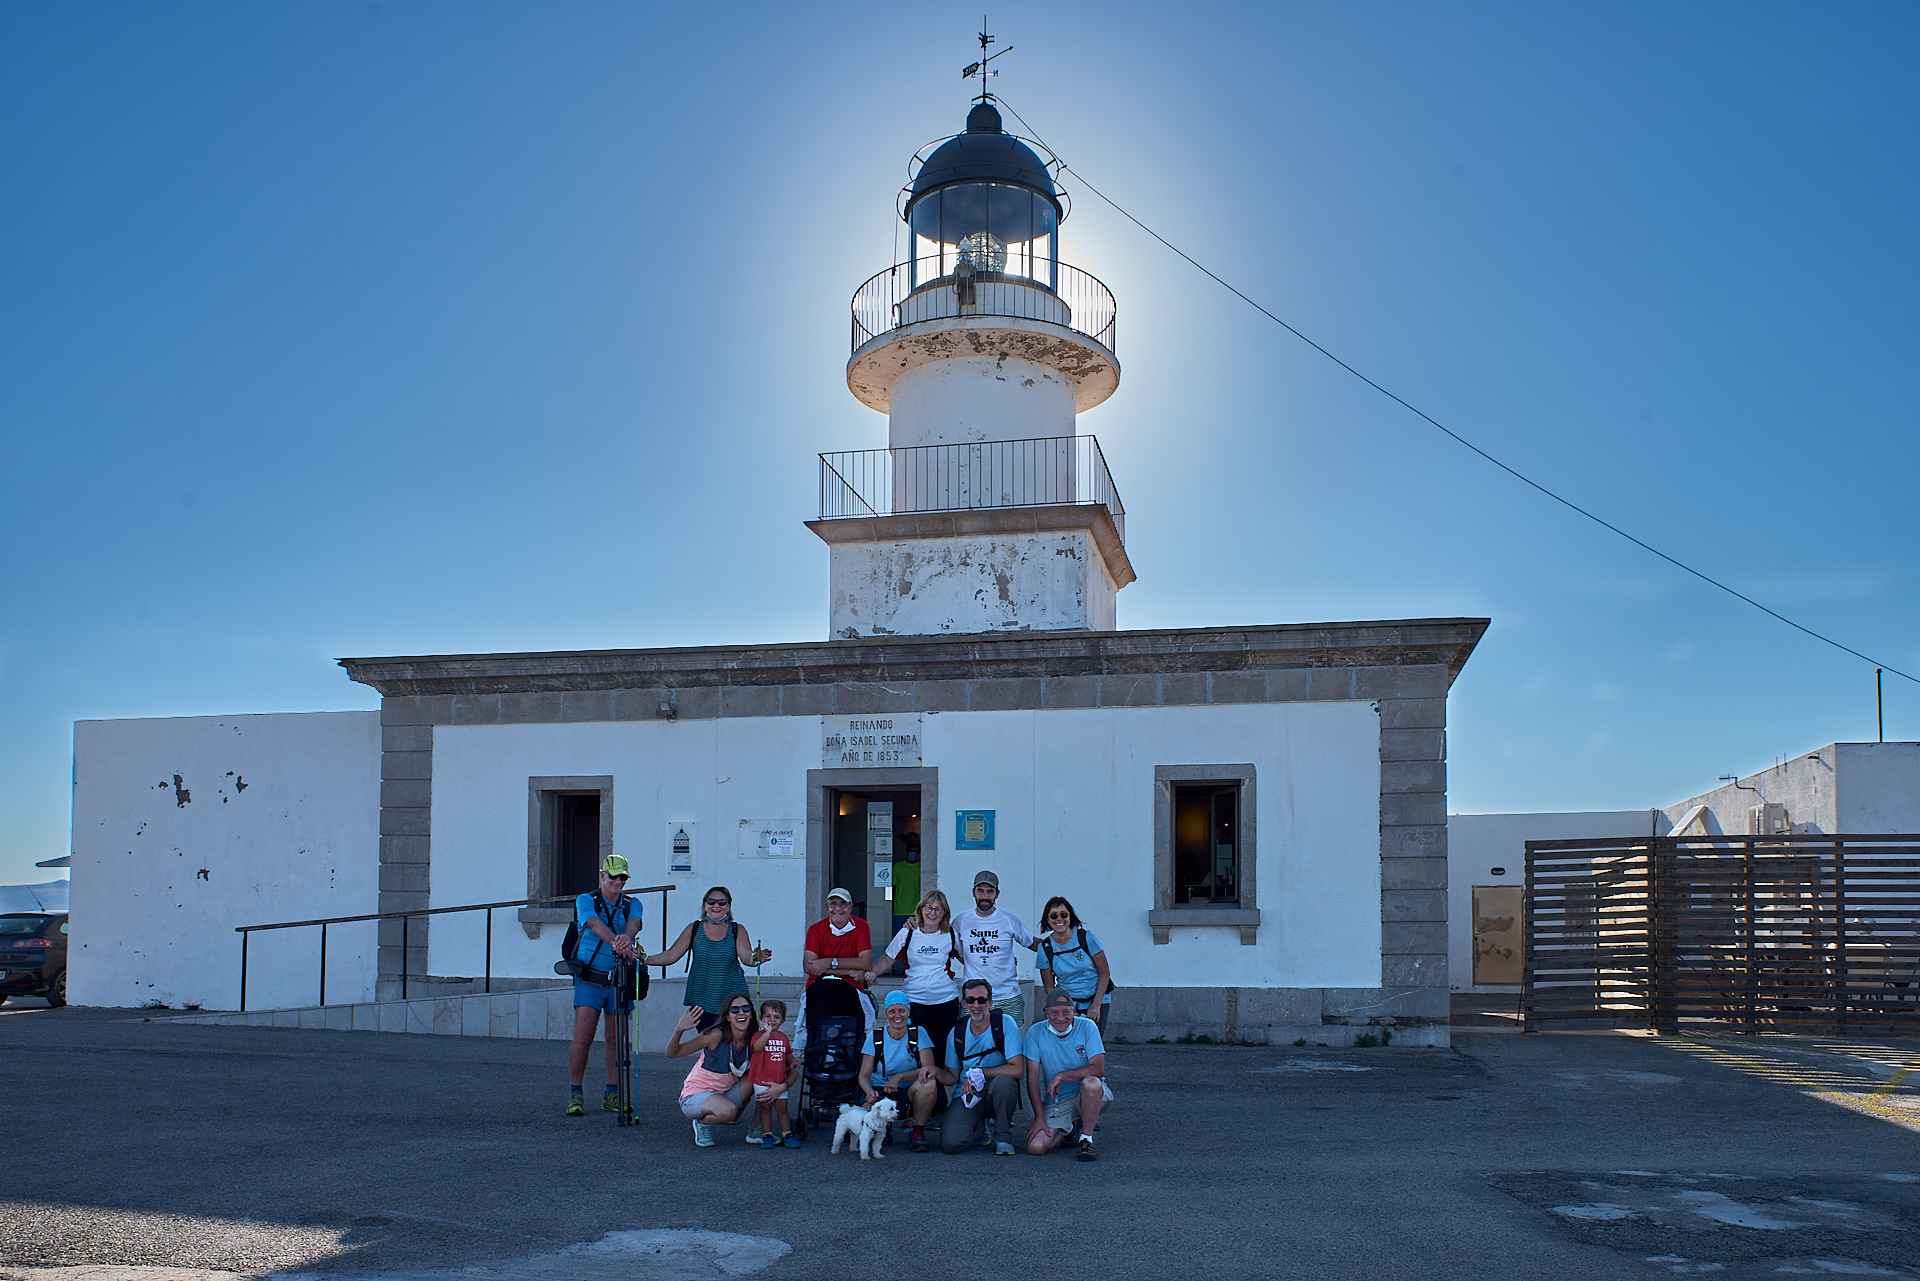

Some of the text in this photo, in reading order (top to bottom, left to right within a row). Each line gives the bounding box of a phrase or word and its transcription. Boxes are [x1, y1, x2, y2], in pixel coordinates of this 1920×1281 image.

[850, 720, 893, 730] REINANDO
[826, 733, 847, 747] DOÑA
[881, 734, 918, 746] SECUNDA
[841, 749, 860, 762] AÑO
[863, 751, 873, 761] DE
[969, 929, 999, 939] Sang
[979, 937, 989, 945] &
[969, 944, 1000, 954] Fetge
